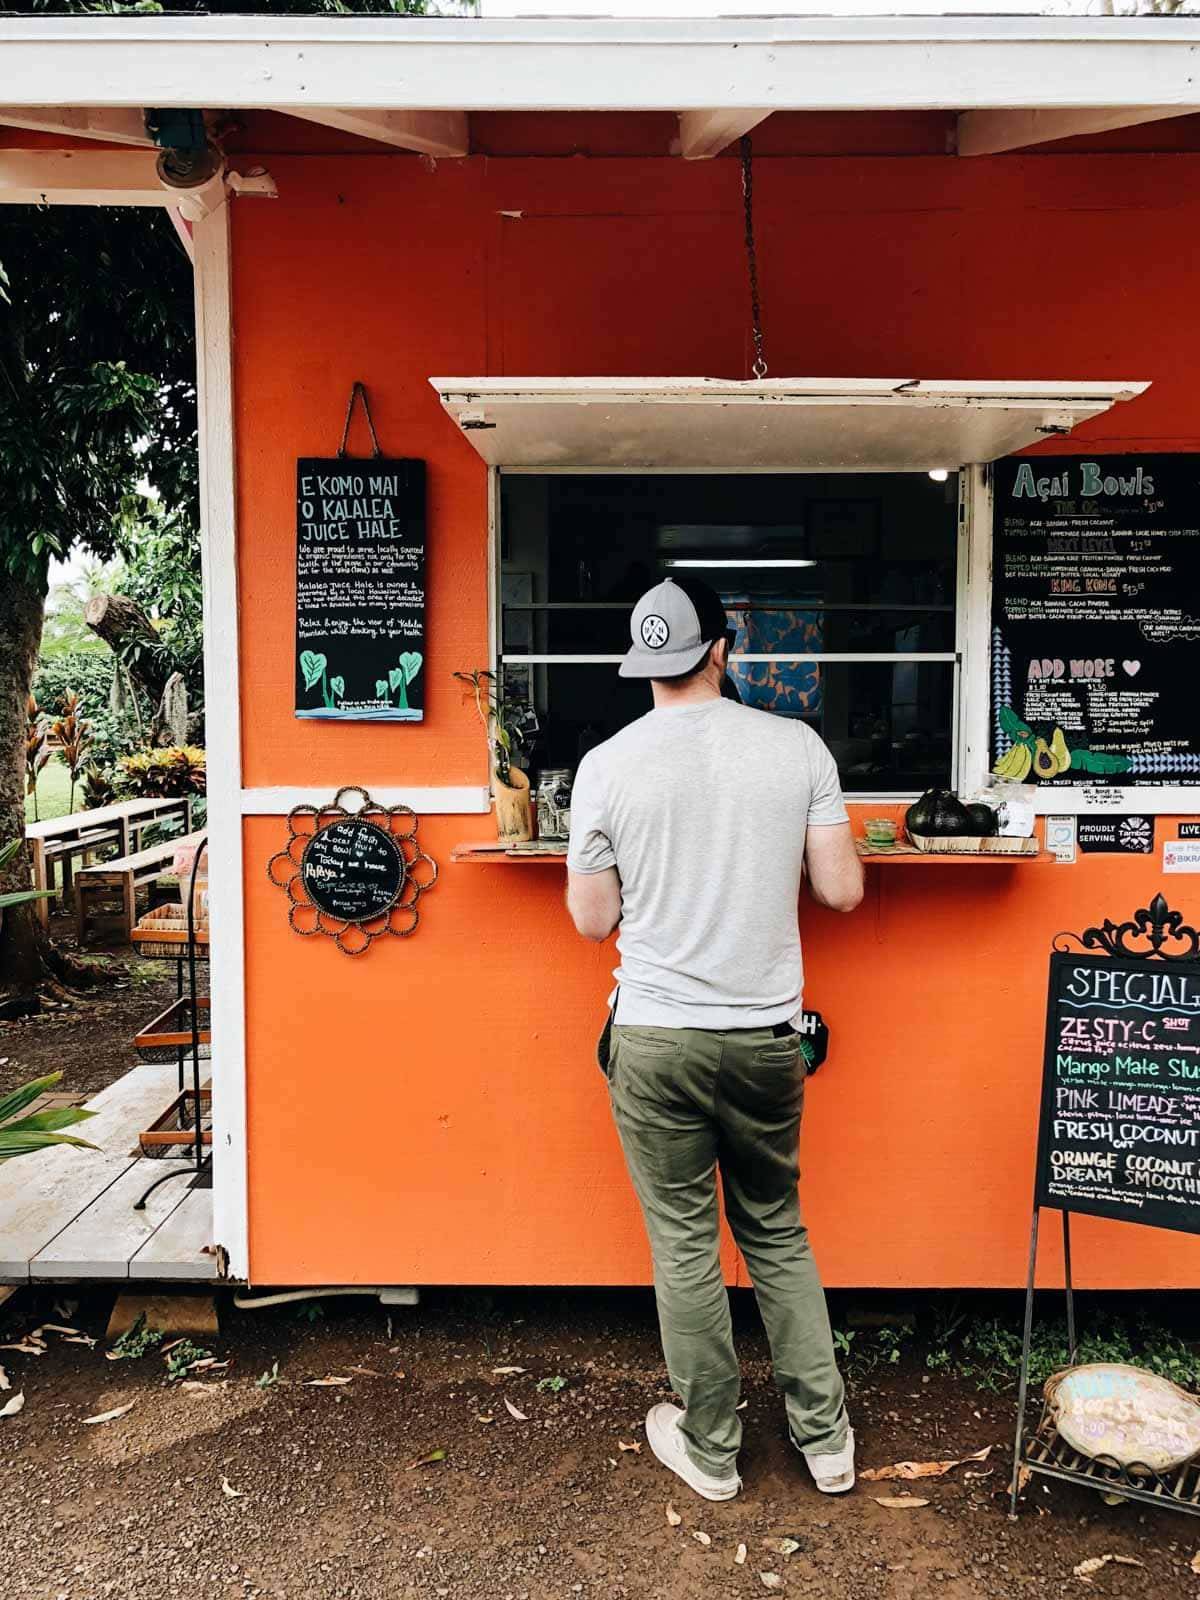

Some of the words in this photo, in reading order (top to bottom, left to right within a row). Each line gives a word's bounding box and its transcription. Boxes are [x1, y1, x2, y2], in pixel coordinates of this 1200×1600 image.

[301, 476, 315, 496] E
[317, 476, 364, 496] KOMO
[368, 476, 399, 497] MAI
[1080, 462, 1155, 497] Bowls
[321, 498, 395, 521] KALALEA
[301, 521, 350, 541] JUICE
[356, 519, 403, 539] HALE
[1051, 579, 1082, 593] KING
[1085, 578, 1117, 593] KONG
[1028, 658, 1065, 679] ADD
[1069, 658, 1116, 678] MORE
[337, 826, 355, 837] add
[1079, 824, 1116, 833] PROUDLY
[1079, 834, 1116, 843] SERVING
[313, 841, 328, 853] any
[1060, 1016, 1156, 1041] ZESTY-C
[1162, 1016, 1191, 1028] SHOT
[1056, 1054, 1111, 1080] Mango
[1115, 1055, 1160, 1077] Mate
[1056, 1087, 1100, 1110] PINK
[1108, 1089, 1182, 1117] LIMEADE
[1053, 1119, 1114, 1143] FRESH
[1119, 1123, 1200, 1147] COCONUT
[1050, 1150, 1119, 1169] ORANGE
[1125, 1154, 1196, 1176] COCONUT
[1051, 1165, 1113, 1184] DREAM
